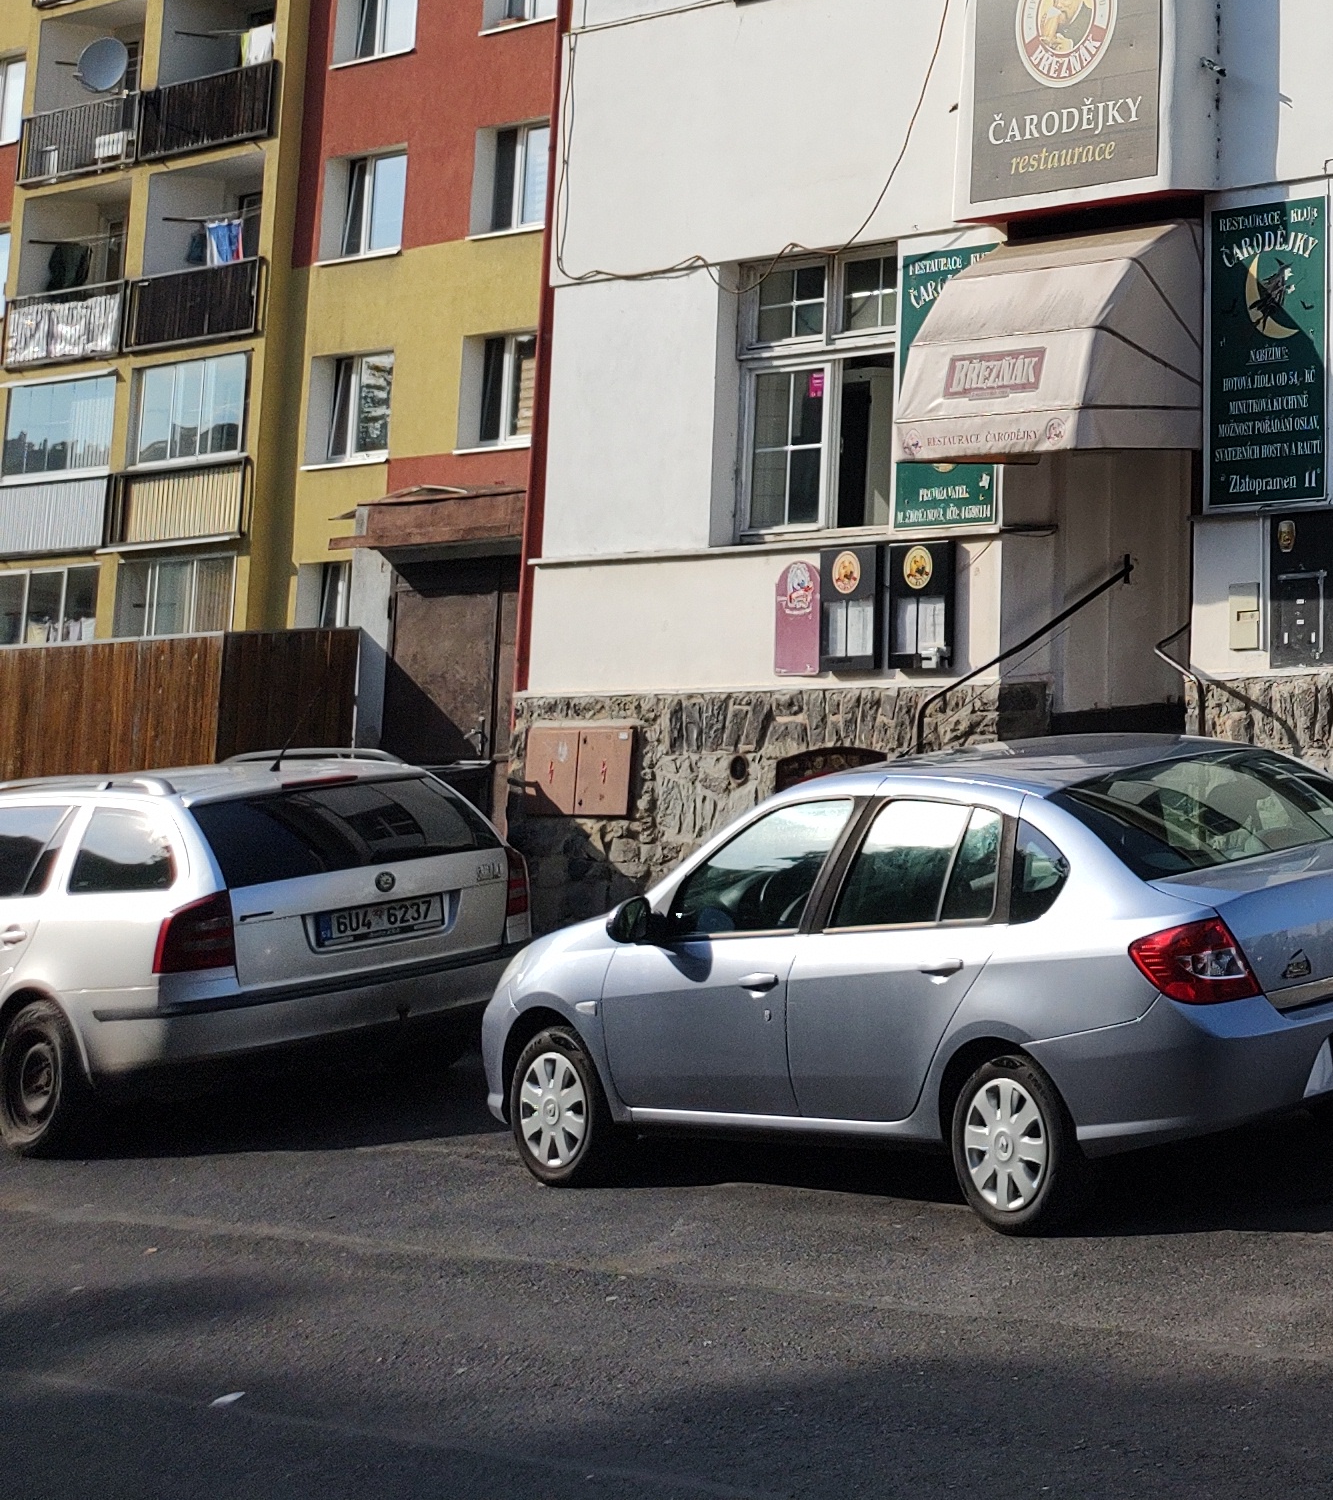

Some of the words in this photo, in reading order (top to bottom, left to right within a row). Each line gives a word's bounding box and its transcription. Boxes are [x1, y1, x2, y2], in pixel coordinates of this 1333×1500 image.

[988, 97, 1142, 145] ČARODĚJKY
[1010, 140, 1116, 175] restaurace
[1219, 211, 1280, 232] RESTAURACE
[1220, 225, 1319, 268] ČARODĚJKY
[950, 355, 1039, 392] BŘEZŇÁK
[1253, 370, 1275, 389] JÍDLA
[1276, 372, 1287, 386] OD
[1229, 474, 1297, 495] Zlatopramen
[336, 910, 373, 935] 6U4
[386, 899, 433, 926] 6237
